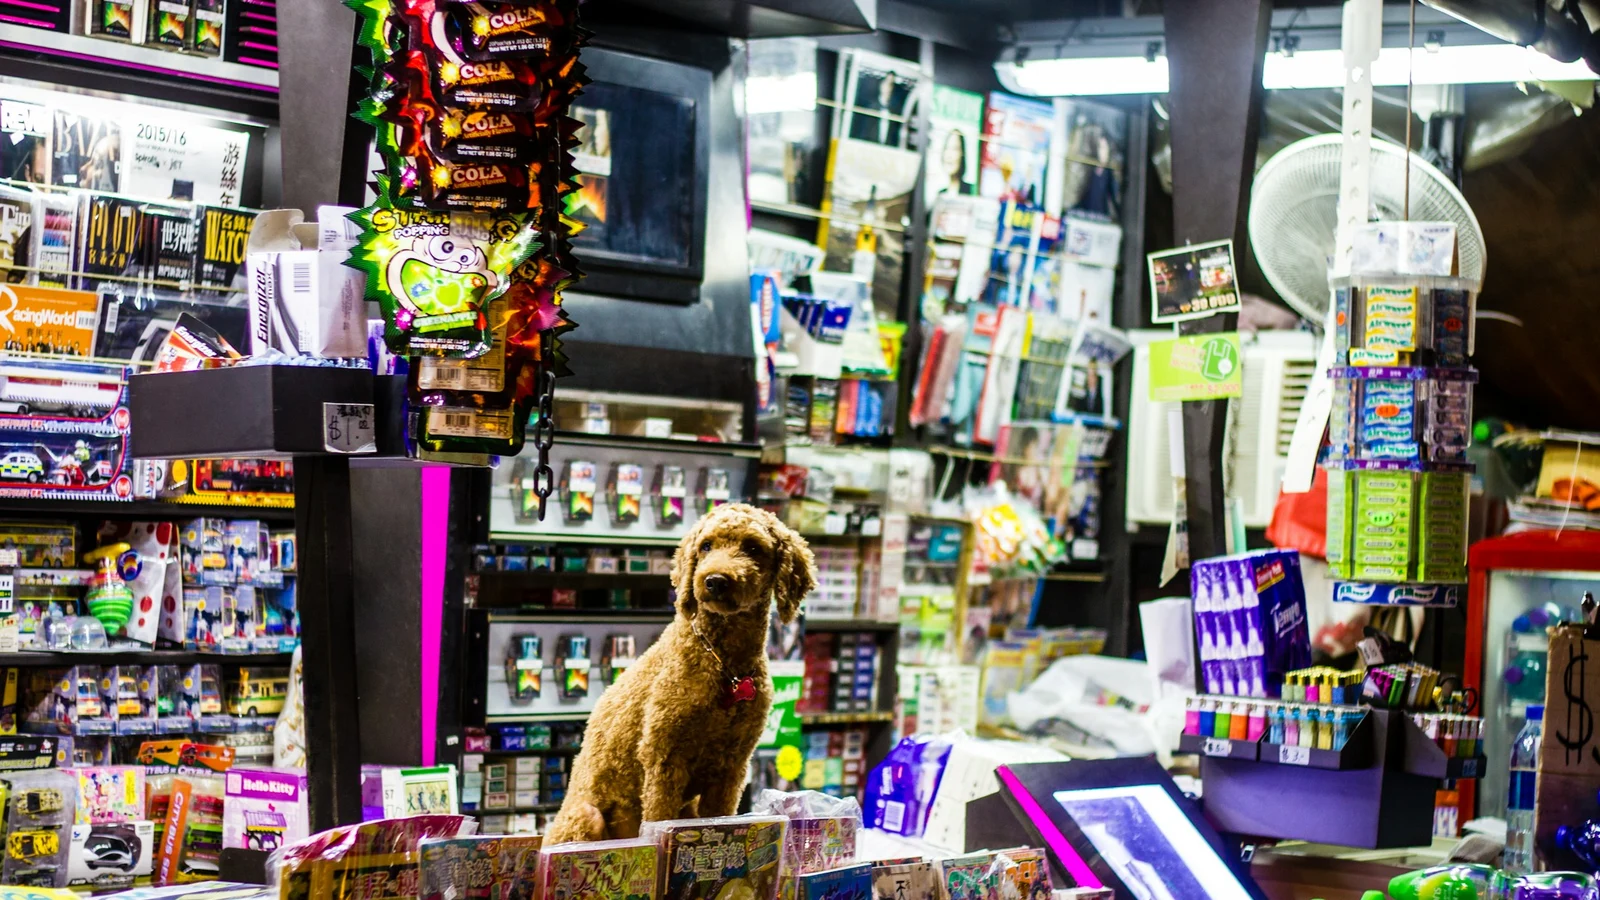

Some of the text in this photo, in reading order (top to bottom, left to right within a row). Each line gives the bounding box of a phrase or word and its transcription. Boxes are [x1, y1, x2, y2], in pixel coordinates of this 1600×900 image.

[490, 7, 538, 29] COLA
[460, 61, 512, 79] COLA
[462, 114, 513, 132] COLA
[136, 123, 187, 146] 2015/16
[453, 165, 503, 182] COLA
[394, 225, 449, 240] POPPING
[1369, 286, 1412, 296] Airwaves
[256, 267, 269, 345] Energizer
[1369, 303, 1412, 313] Airwaves
[1368, 319, 1412, 329] Airwaves
[175, 326, 217, 357] Energizer
[1352, 351, 1395, 361] Airwaves
[1368, 381, 1411, 392] Airwaves
[1367, 396, 1411, 406] Airwaves
[1365, 429, 1410, 440] Airwaves
[1373, 444, 1417, 455] Airwaves
[1270, 602, 1300, 634] Tempo
[177, 765, 213, 776] CITYBUS
[243, 778, 296, 796] Hello Kitty
[165, 791, 184, 855] CITYBUS
